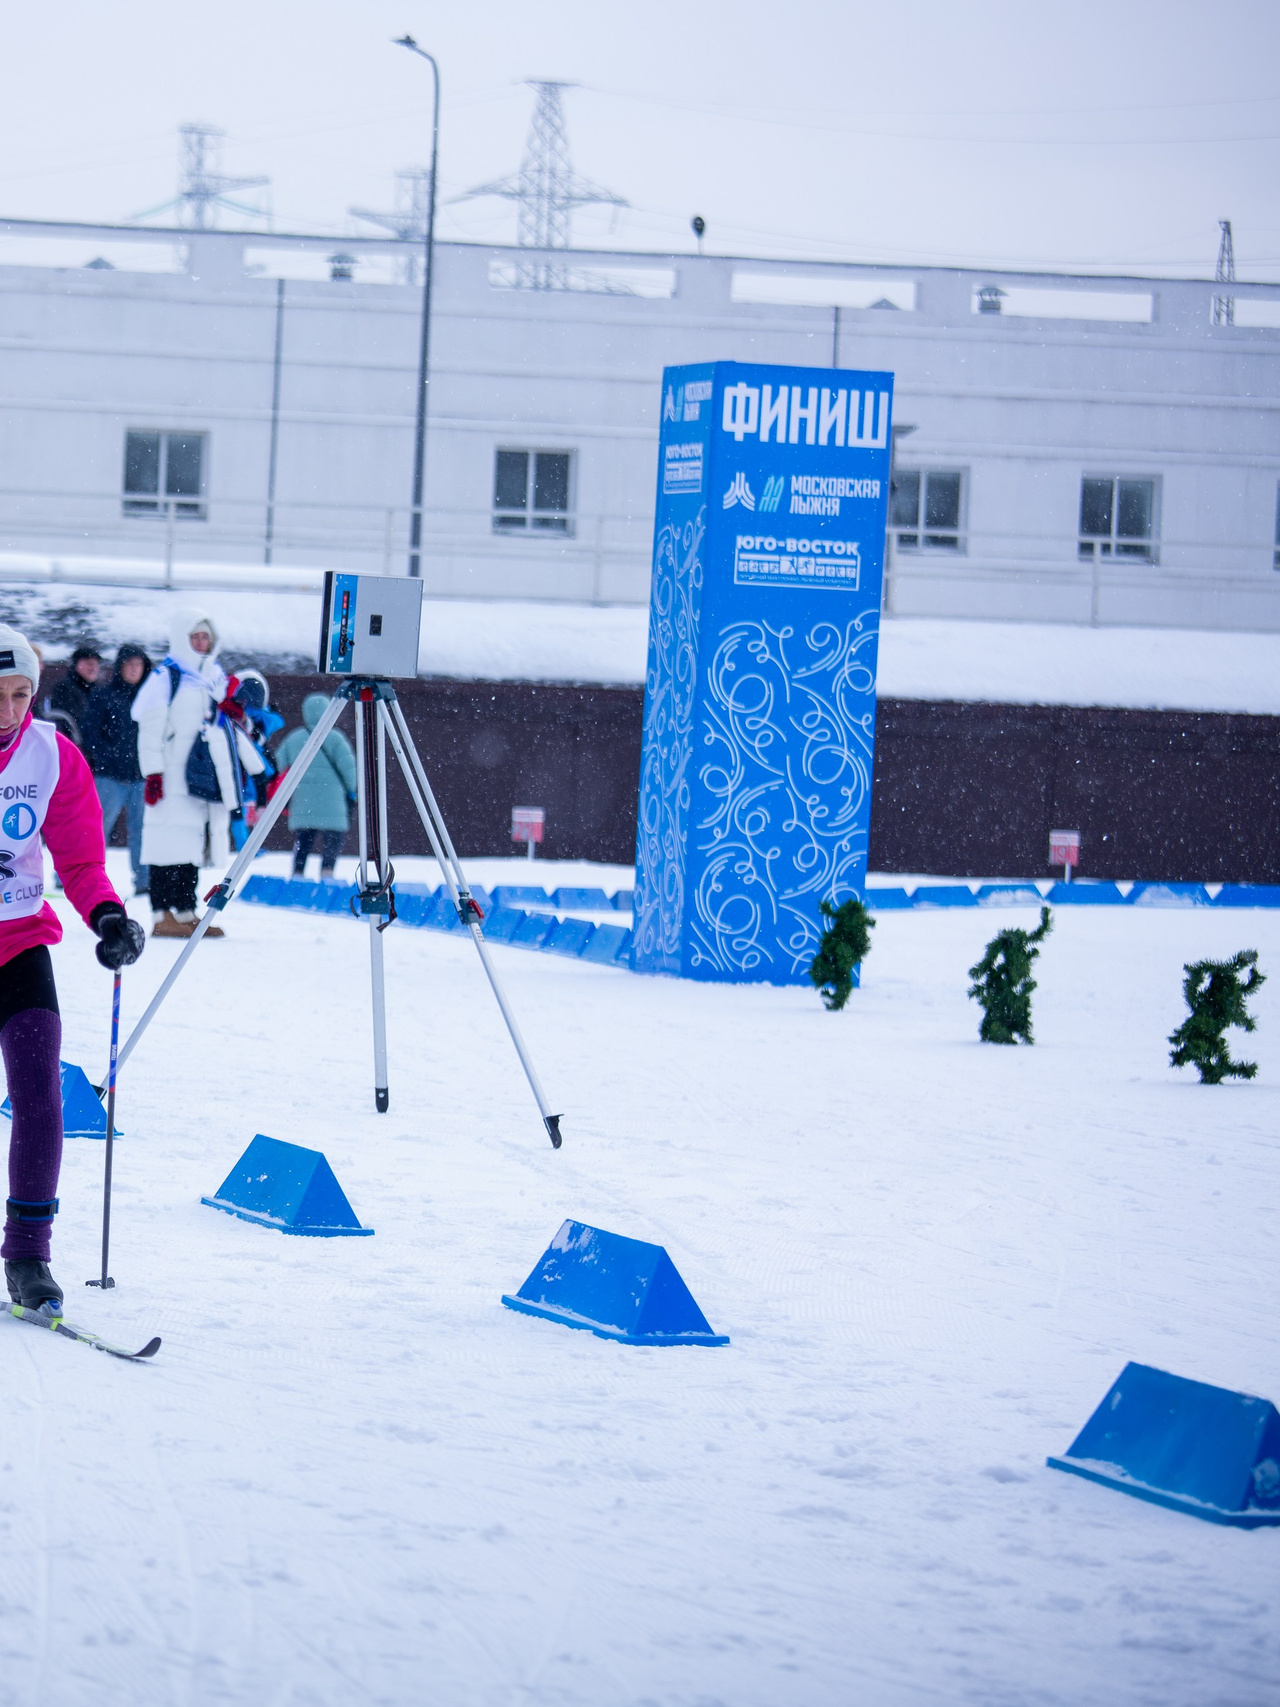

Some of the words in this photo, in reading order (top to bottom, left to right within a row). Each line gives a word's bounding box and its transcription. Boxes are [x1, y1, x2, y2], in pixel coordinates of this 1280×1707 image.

[722, 382, 889, 449] ФИНИШ
[791, 474, 880, 499] МОСКОВСКАЯ
[789, 496, 840, 517] ЛЫЖНЯ
[736, 535, 860, 556] ЮГО-ВОСТОК
